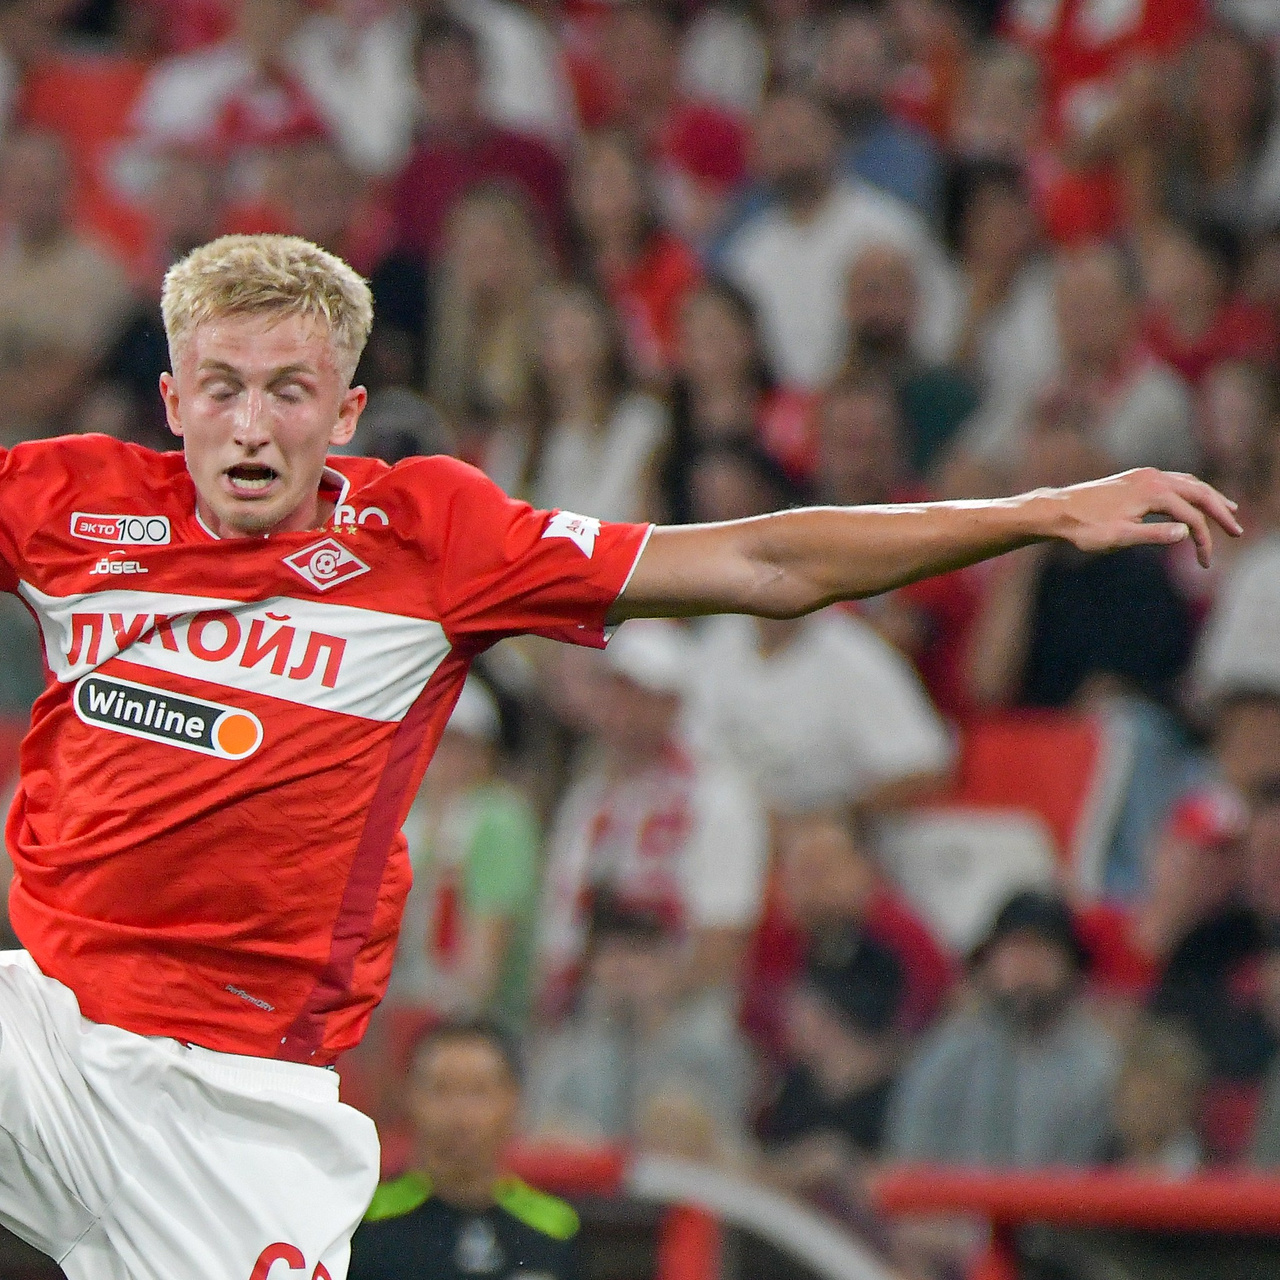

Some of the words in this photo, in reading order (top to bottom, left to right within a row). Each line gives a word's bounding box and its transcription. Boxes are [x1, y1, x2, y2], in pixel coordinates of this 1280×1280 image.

[80, 522, 115, 535] ЭКТО
[118, 519, 167, 542] 100
[89, 558, 149, 575] JÖGEL
[88, 685, 206, 739] Winline
